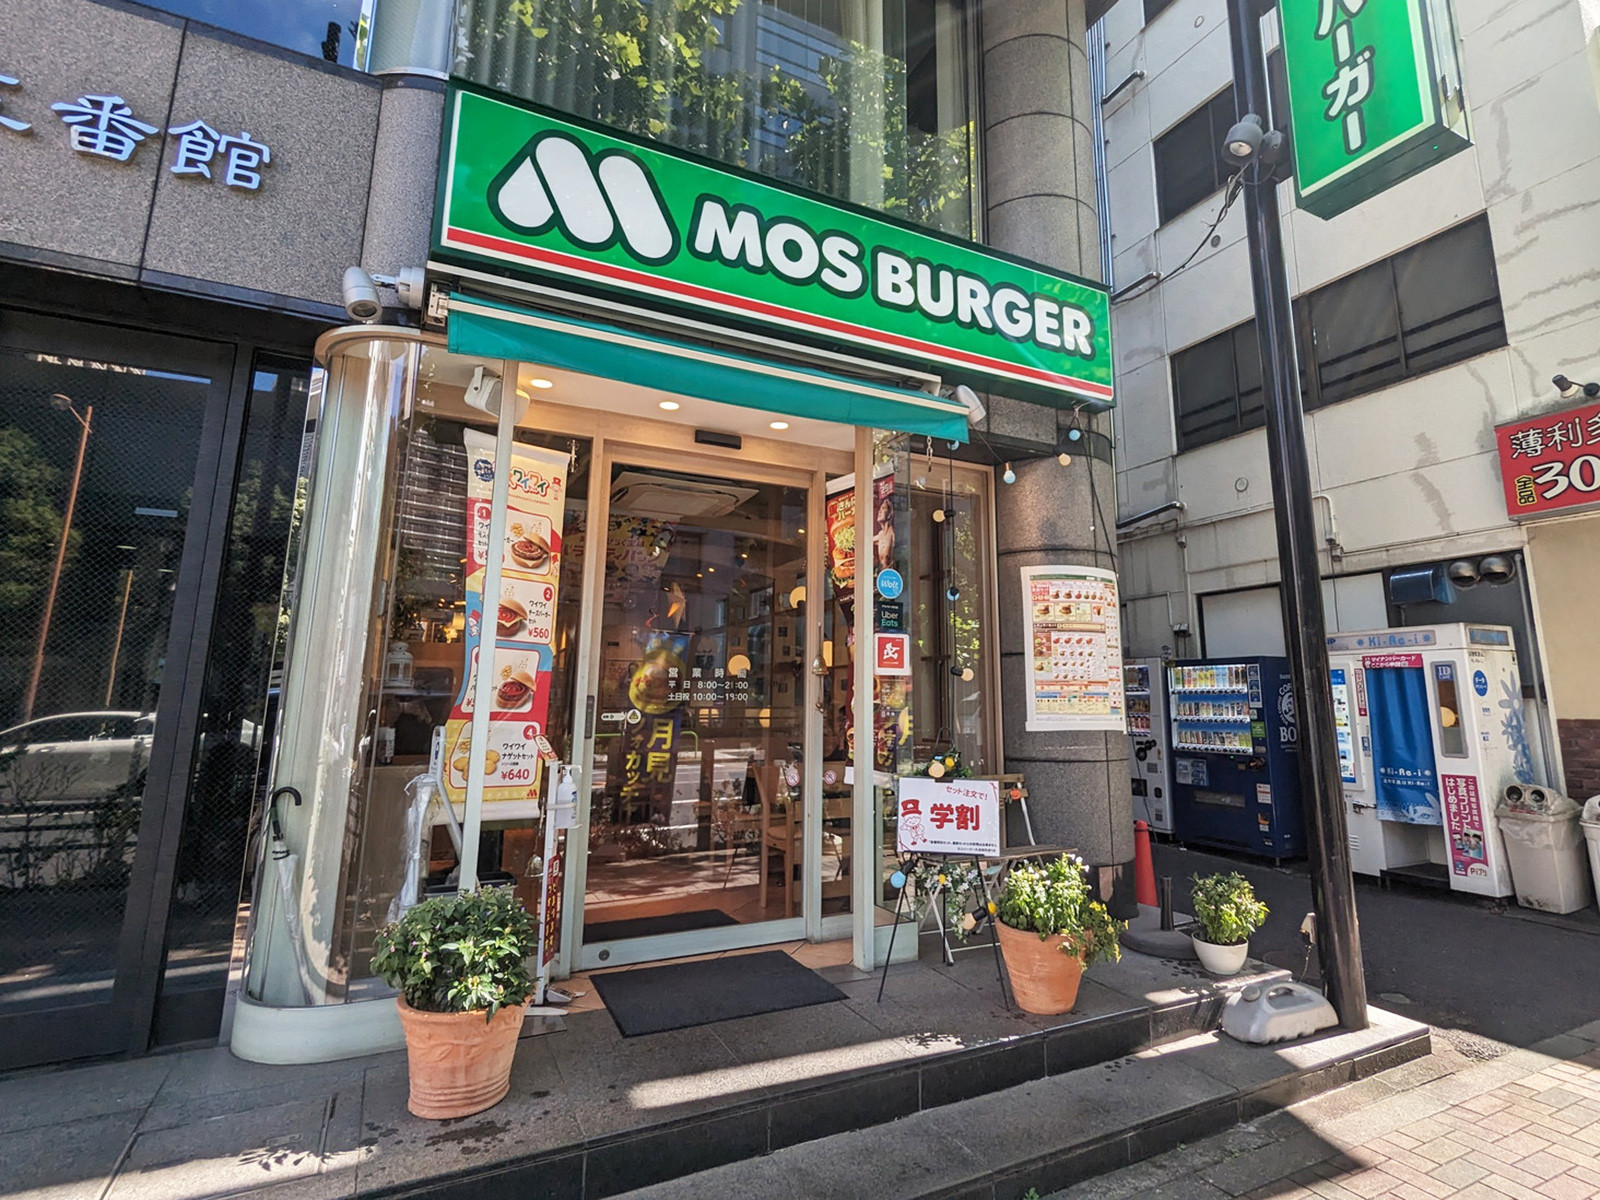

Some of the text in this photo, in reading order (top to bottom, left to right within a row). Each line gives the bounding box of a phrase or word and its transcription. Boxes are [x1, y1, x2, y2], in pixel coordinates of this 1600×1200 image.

[694, 200, 1093, 356] MOS BURGER
[881, 611, 899, 619] Uber
[881, 619, 899, 627] Eats
[528, 627, 550, 639] ¥560
[502, 742, 527, 750] ワイワイ
[646, 718, 675, 784] 月見
[501, 768, 530, 780] ¥640
[1445, 777, 1462, 831] はじめました
[930, 802, 980, 831] 学割
